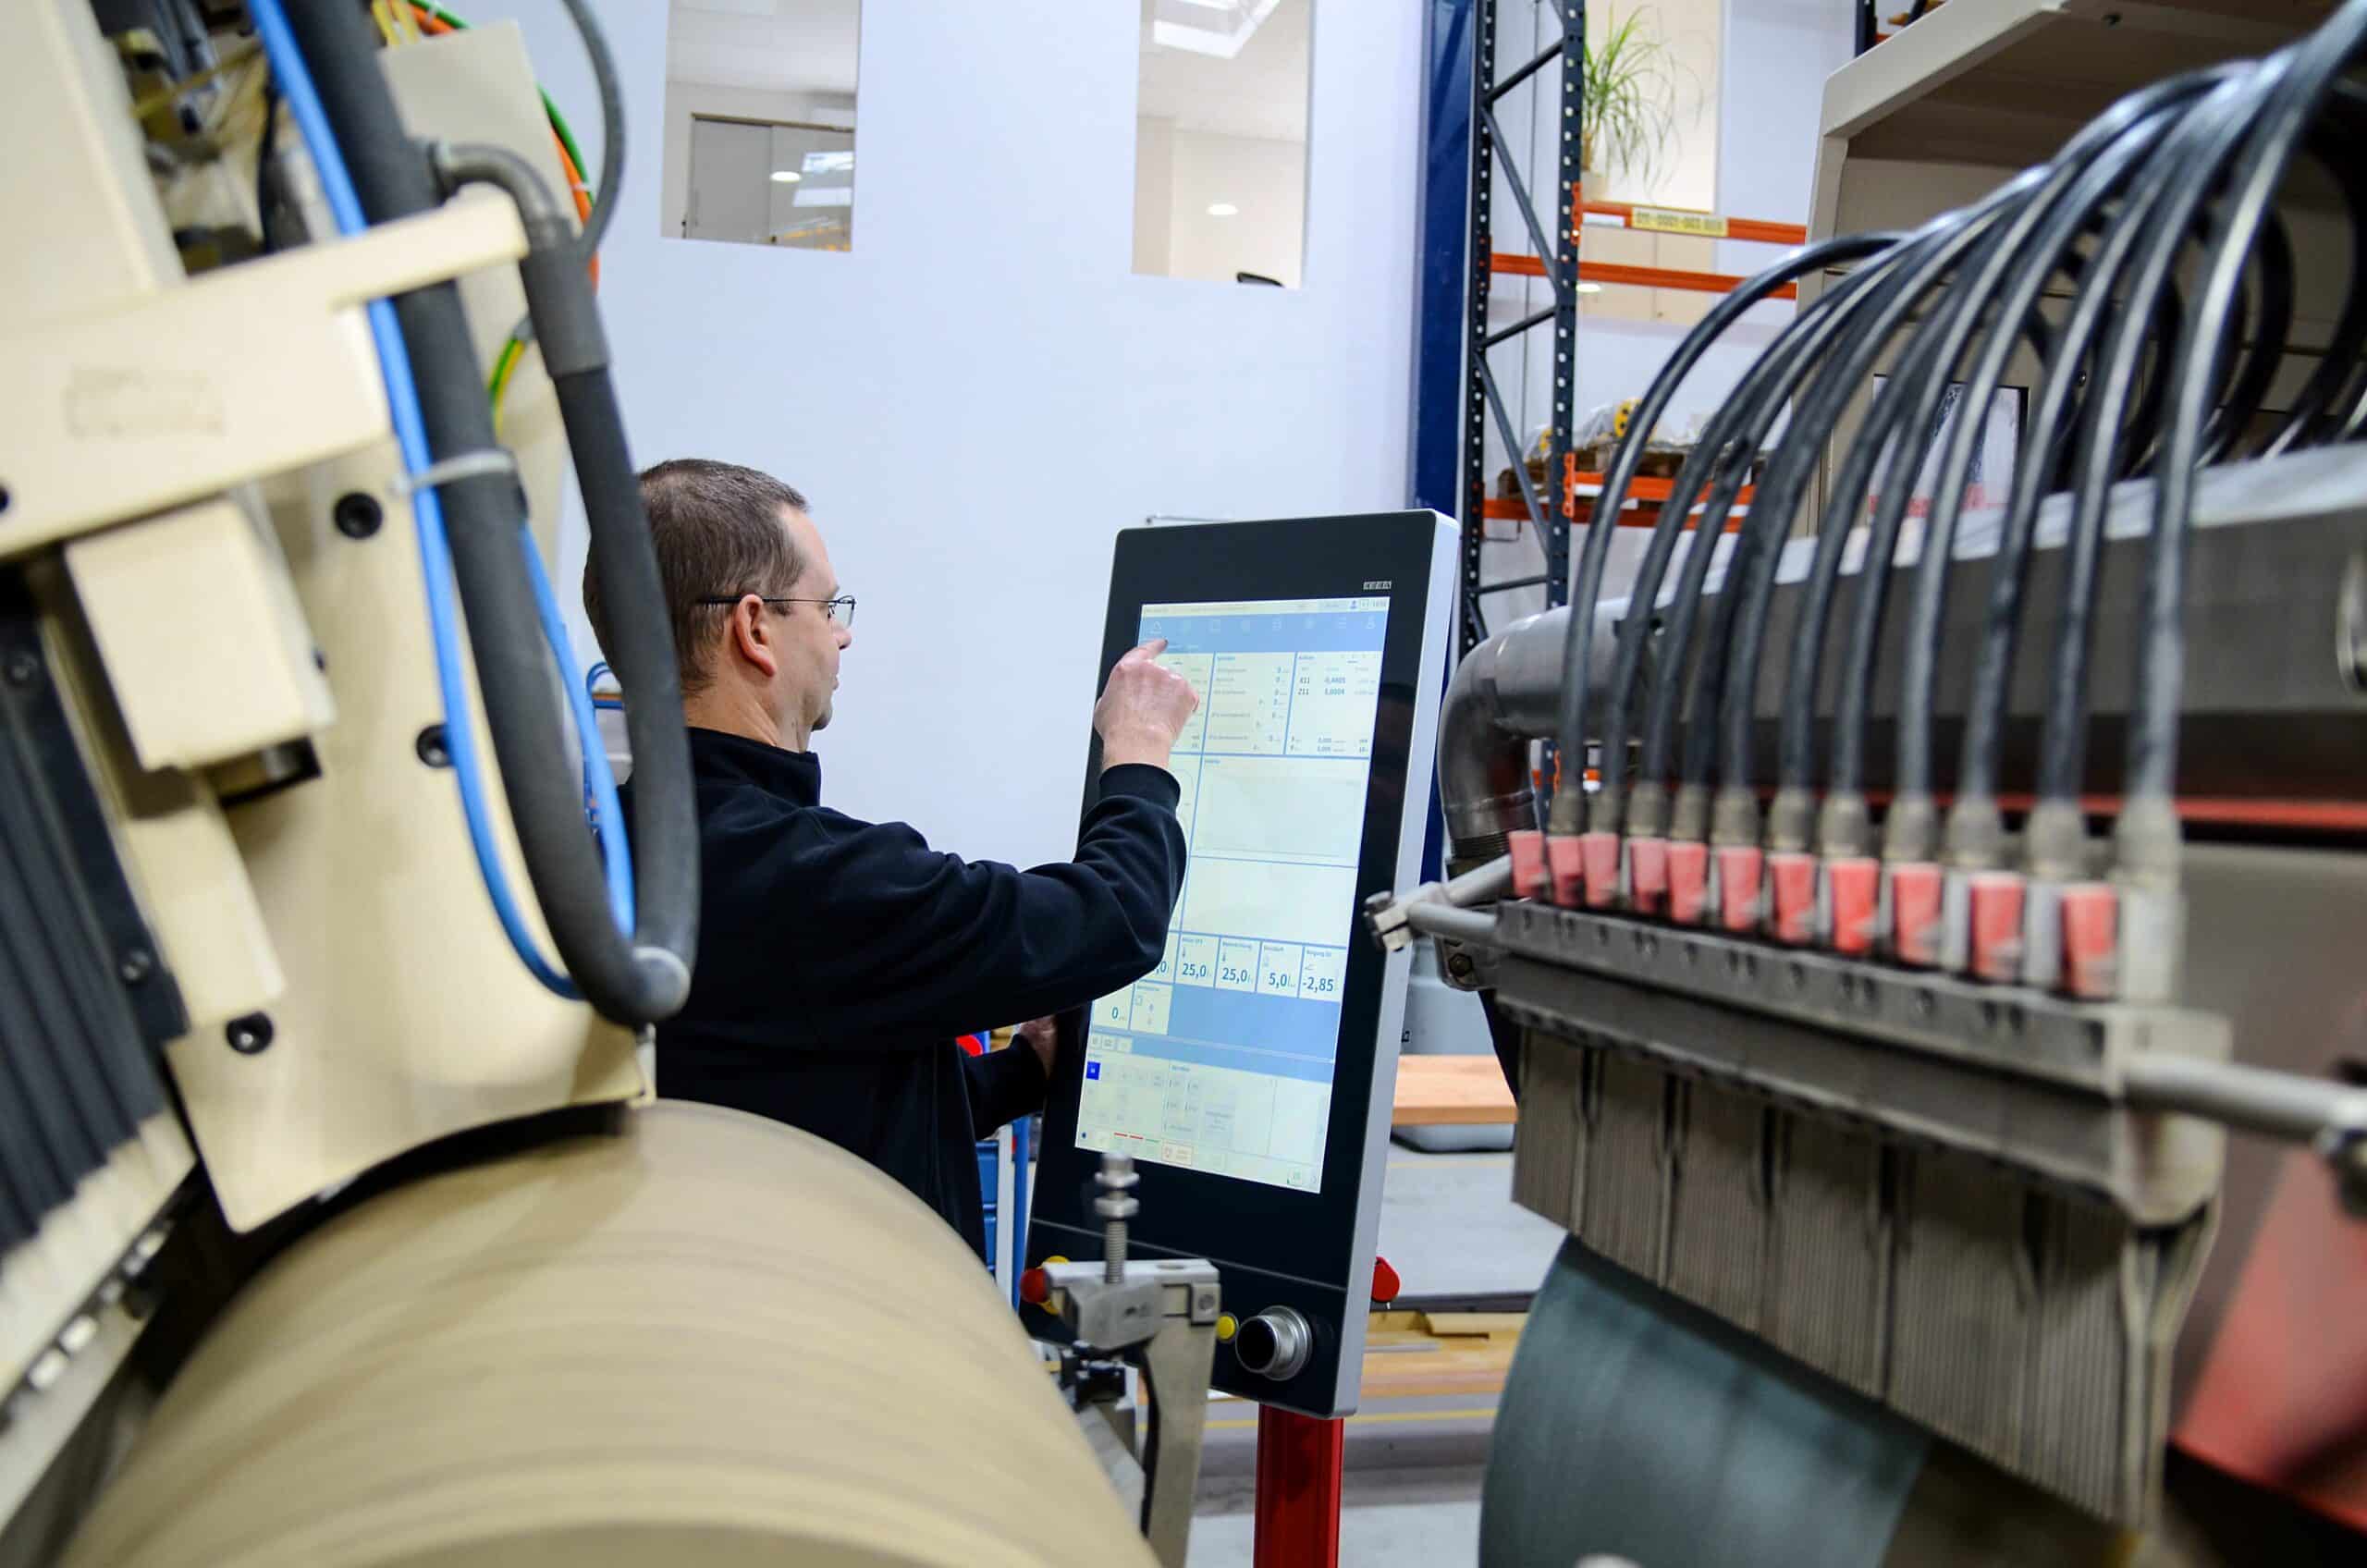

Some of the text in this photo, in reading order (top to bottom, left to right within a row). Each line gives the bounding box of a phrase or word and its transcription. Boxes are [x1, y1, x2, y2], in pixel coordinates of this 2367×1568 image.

[1182, 962, 1207, 979] 25,0
[1221, 967, 1247, 984] 25,0
[1269, 972, 1287, 988] 5,0
[1303, 976, 1333, 993] -2,85
